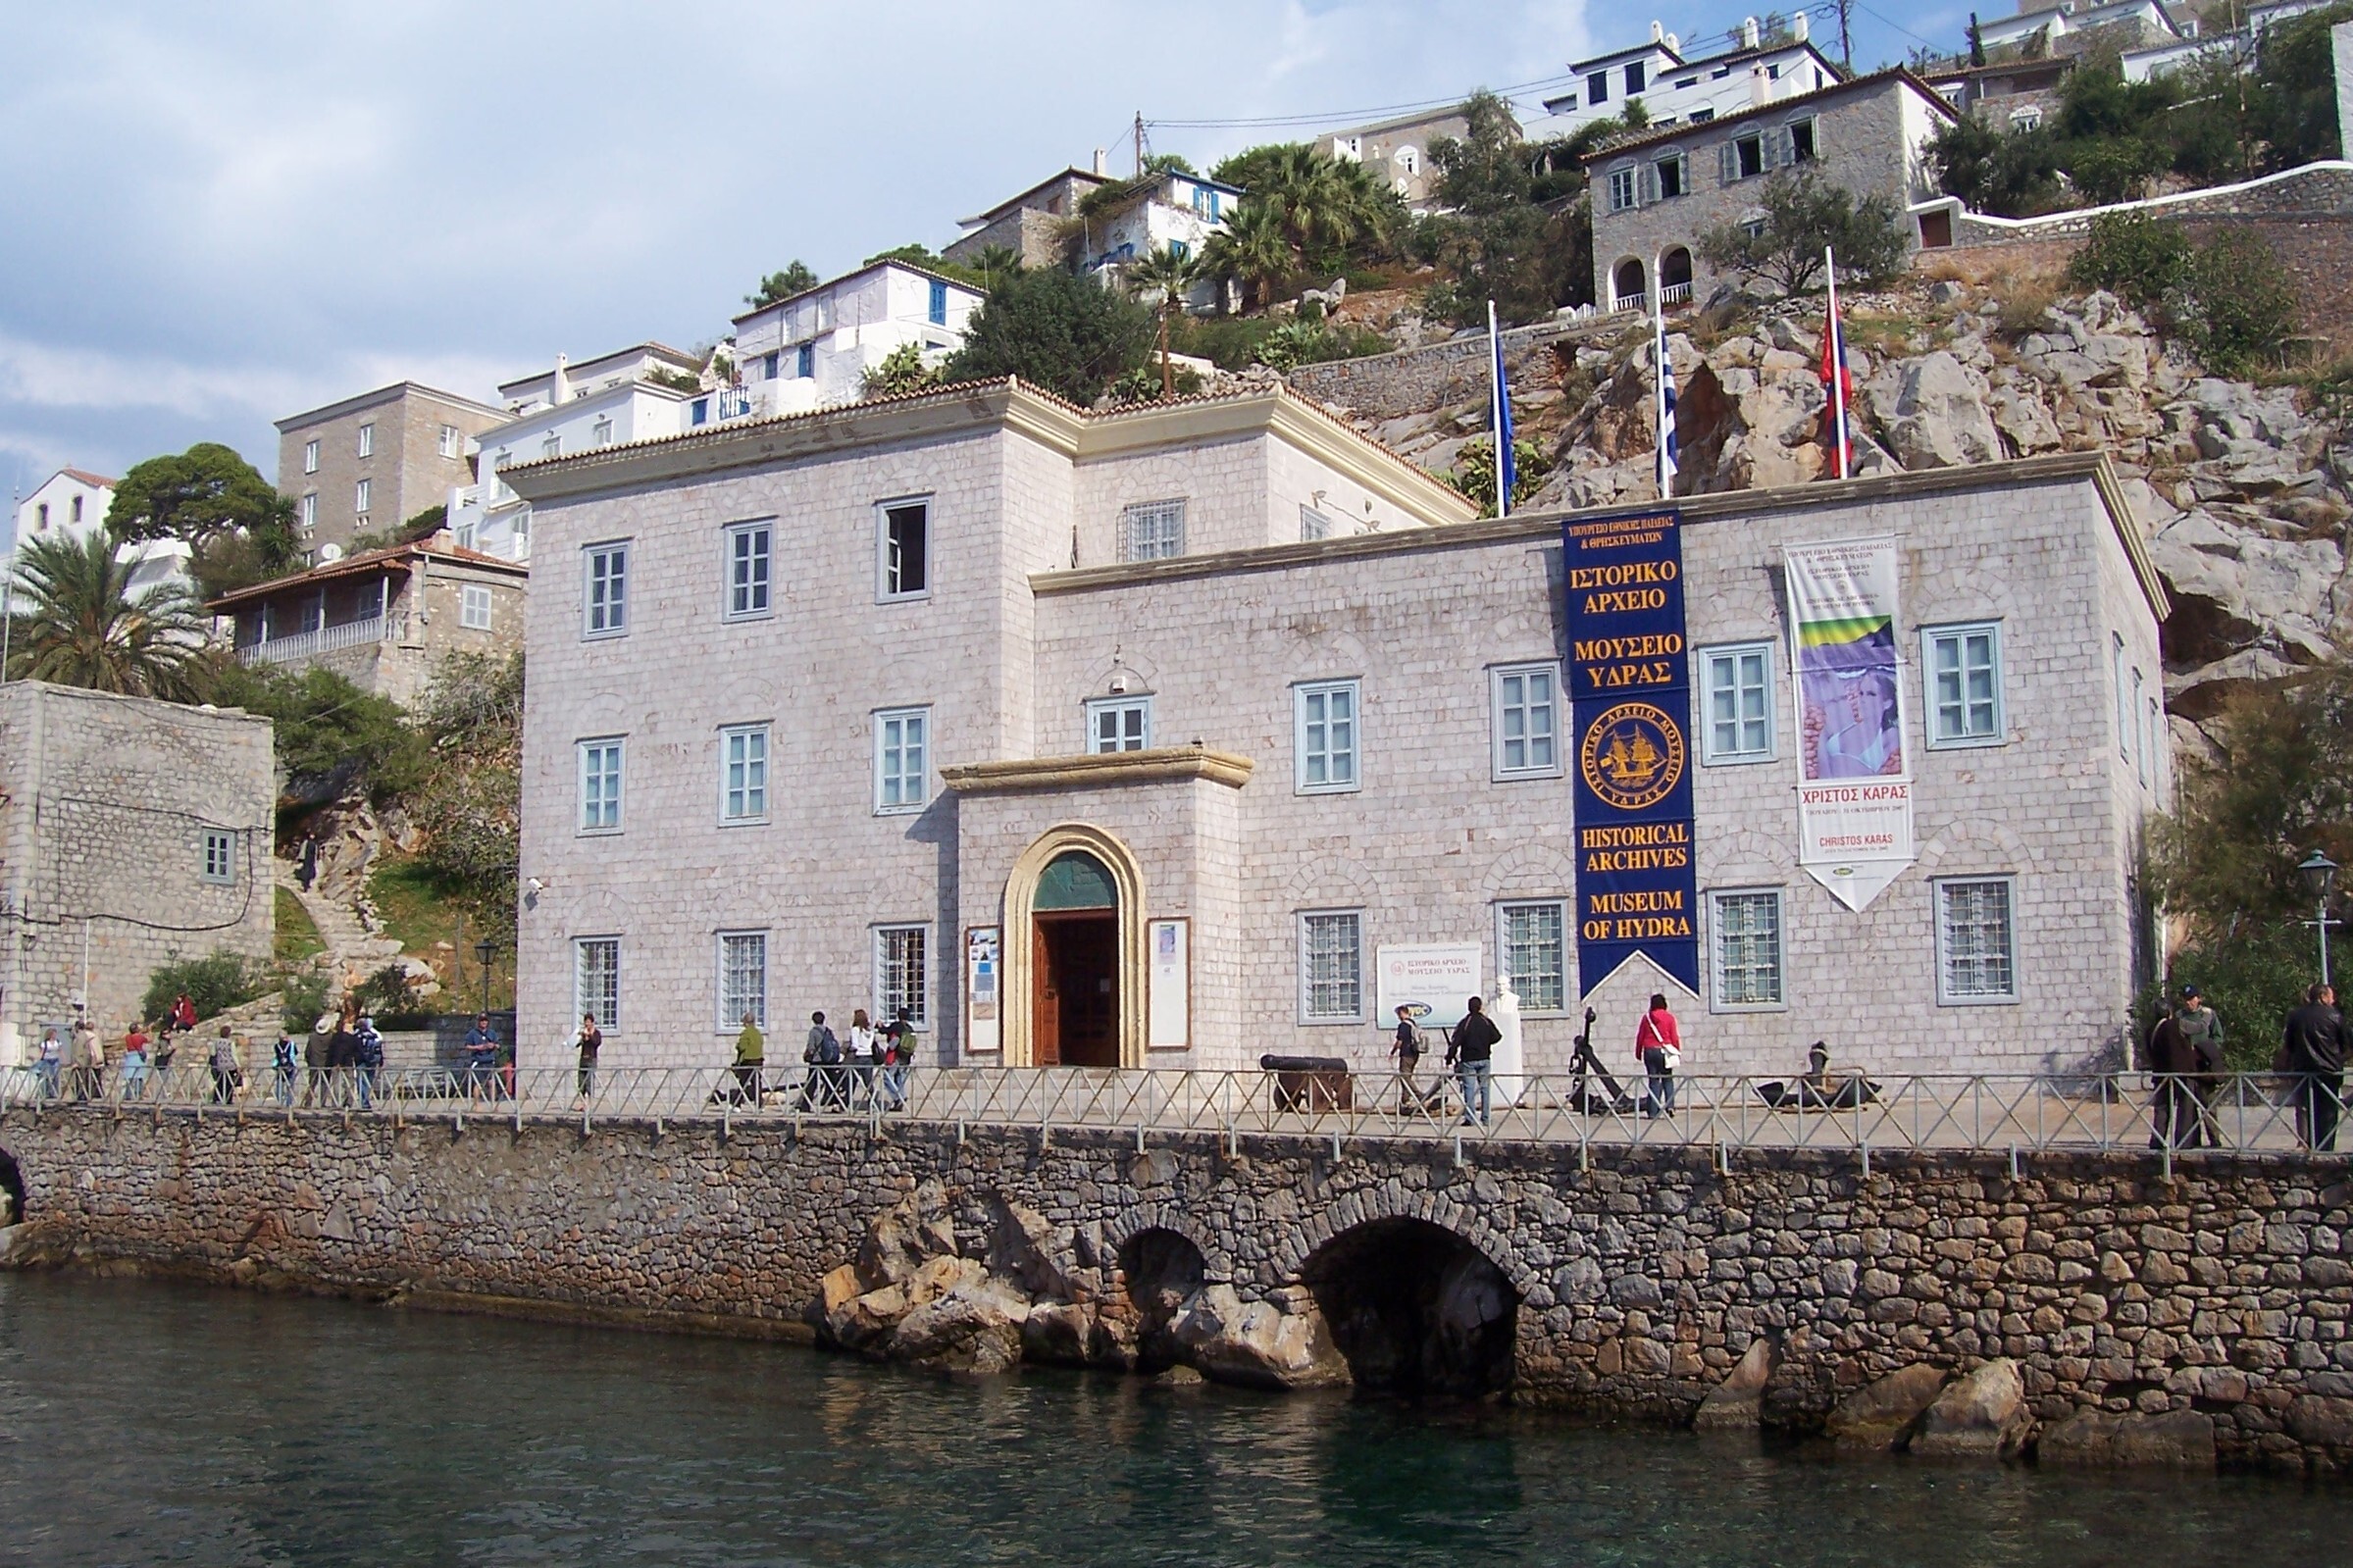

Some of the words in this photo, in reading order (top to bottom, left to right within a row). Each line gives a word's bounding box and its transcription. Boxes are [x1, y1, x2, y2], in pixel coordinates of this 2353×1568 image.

[1568, 523, 1608, 537] ΥΠΟΥΡΓΕΙΟ
[1609, 520, 1640, 532] ΕΘΝΙΚΗΣ
[1641, 516, 1674, 530] ΠΑΙΔΕΙΑΣ
[1580, 538, 1588, 549] &
[1589, 531, 1662, 548] ΘΡΗΣΚΕΥΜΑΤΩΝ
[1570, 560, 1677, 589] ΙΣΤΟΡΙΚΟ
[1583, 588, 1666, 614] ΑΡΧΕΙΟ
[1574, 633, 1682, 661] ΜΟΥΣΕΙΟ
[1587, 662, 1672, 687] ΥΔΡΑΣ
[1585, 725, 1604, 791] ΙΣΤΟΡΙΚΟ
[1608, 706, 1656, 724] ΑΡΧΕΙΟ
[1660, 720, 1680, 783] ΜΟΥΣΕΙΟ
[1611, 787, 1663, 804] ΥΔΡΑΣ
[1803, 787, 1859, 804] ΧΡΙΣΤΟΣ
[1863, 784, 1908, 800] ΚΑΡΑΣ
[1582, 824, 1689, 848] HISTORICAL
[1819, 835, 1862, 847] CHRISTOS
[1865, 834, 1893, 844] KARAS
[1586, 847, 1687, 872] ARCHIVES
[1590, 889, 1683, 914] MUSEUM
[1583, 920, 1611, 940] OF
[1616, 916, 1691, 938] HYDRA
